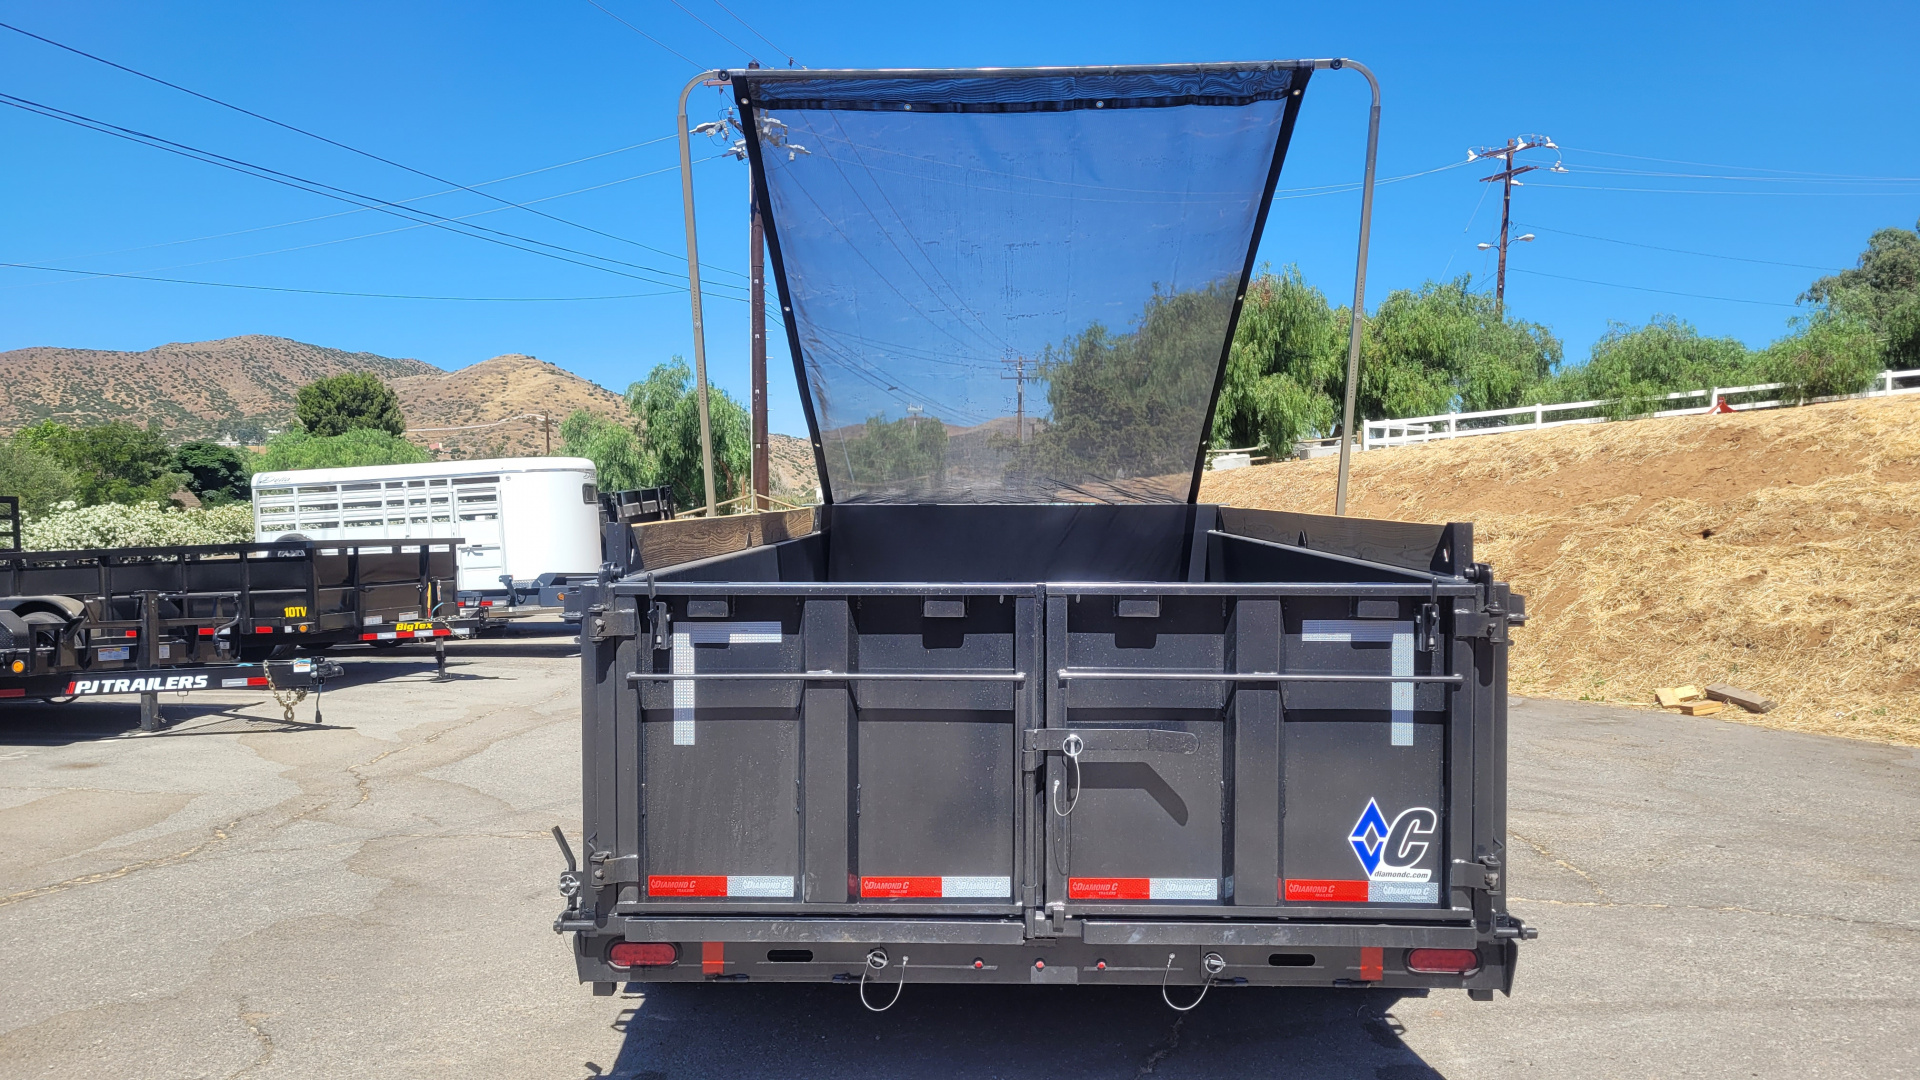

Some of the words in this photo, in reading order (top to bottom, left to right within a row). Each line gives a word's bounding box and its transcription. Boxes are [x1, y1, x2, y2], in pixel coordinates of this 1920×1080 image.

[284, 606, 307, 618] 10TV
[74, 680, 99, 694] PJ
[100, 675, 208, 693] TRAILERS
[1374, 870, 1428, 879] diamondc.com
[655, 880, 689, 889] DIAMOND
[869, 881, 902, 889] DIAMOND
[1077, 882, 1111, 891] DIAMOND
[1293, 884, 1327, 893] DIAMOND
[1388, 886, 1422, 895] DIAMOND
